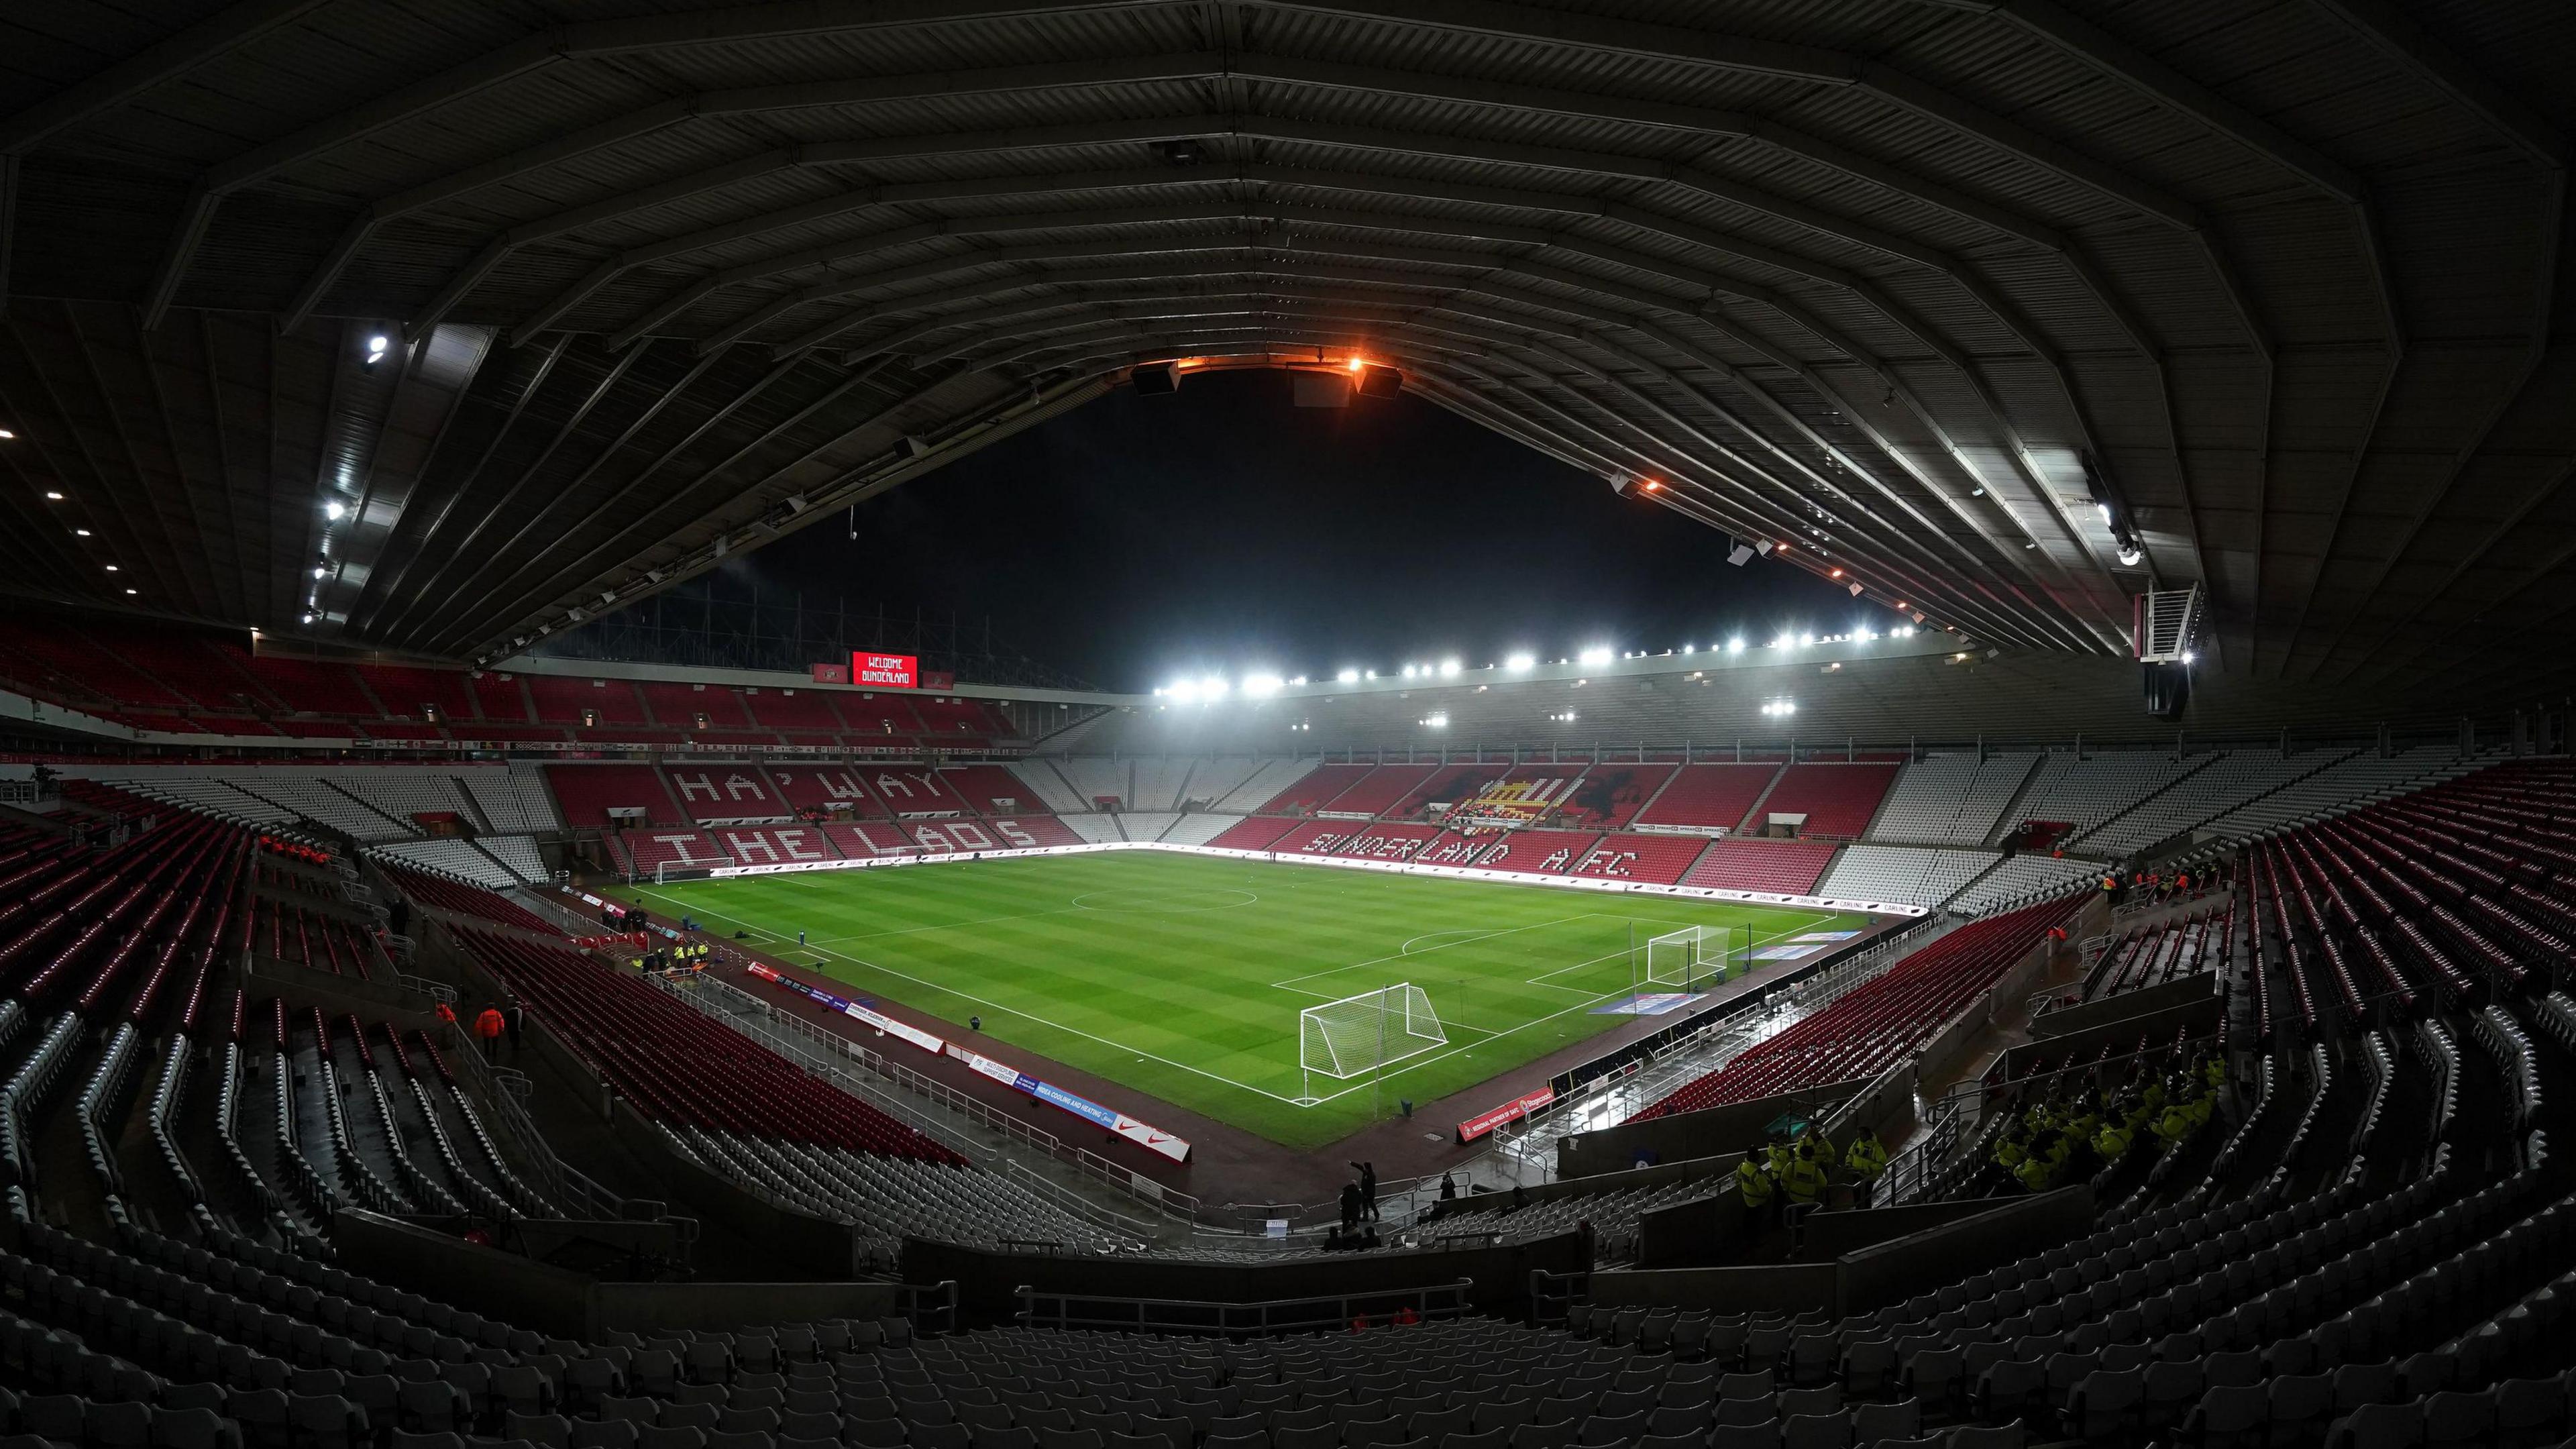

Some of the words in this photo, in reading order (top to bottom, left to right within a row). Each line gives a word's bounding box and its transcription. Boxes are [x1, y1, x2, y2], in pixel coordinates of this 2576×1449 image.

[868, 657, 903, 669] WELCOME
[862, 670, 910, 684] SUNDERLAND
[653, 830, 822, 867] THE
[853, 821, 1036, 853] LADS
[1303, 834, 1509, 864] SUNDERLAND
[1646, 884, 1665, 892] CARLING
[1681, 888, 1701, 896] CARLING
[1718, 890, 1739, 898] CARLING
[1757, 894, 1778, 902] CARLING
[1797, 897, 1820, 906] CARLING
[1839, 900, 1864, 910] CARLING
[1884, 904, 1908, 914] CARLING
[1037, 1085, 1051, 1096] MIDEA
[1051, 1091, 1071, 1104] COOLING
[1070, 1100, 1081, 1110] AND
[1081, 1104, 1102, 1118] HEATING
[1526, 1092, 1554, 1108] Stagecoach
[1472, 1121, 1491, 1132] REGIONAL
[1489, 1113, 1505, 1124] PARTNER
[1509, 1107, 1519, 1116] SAFC
